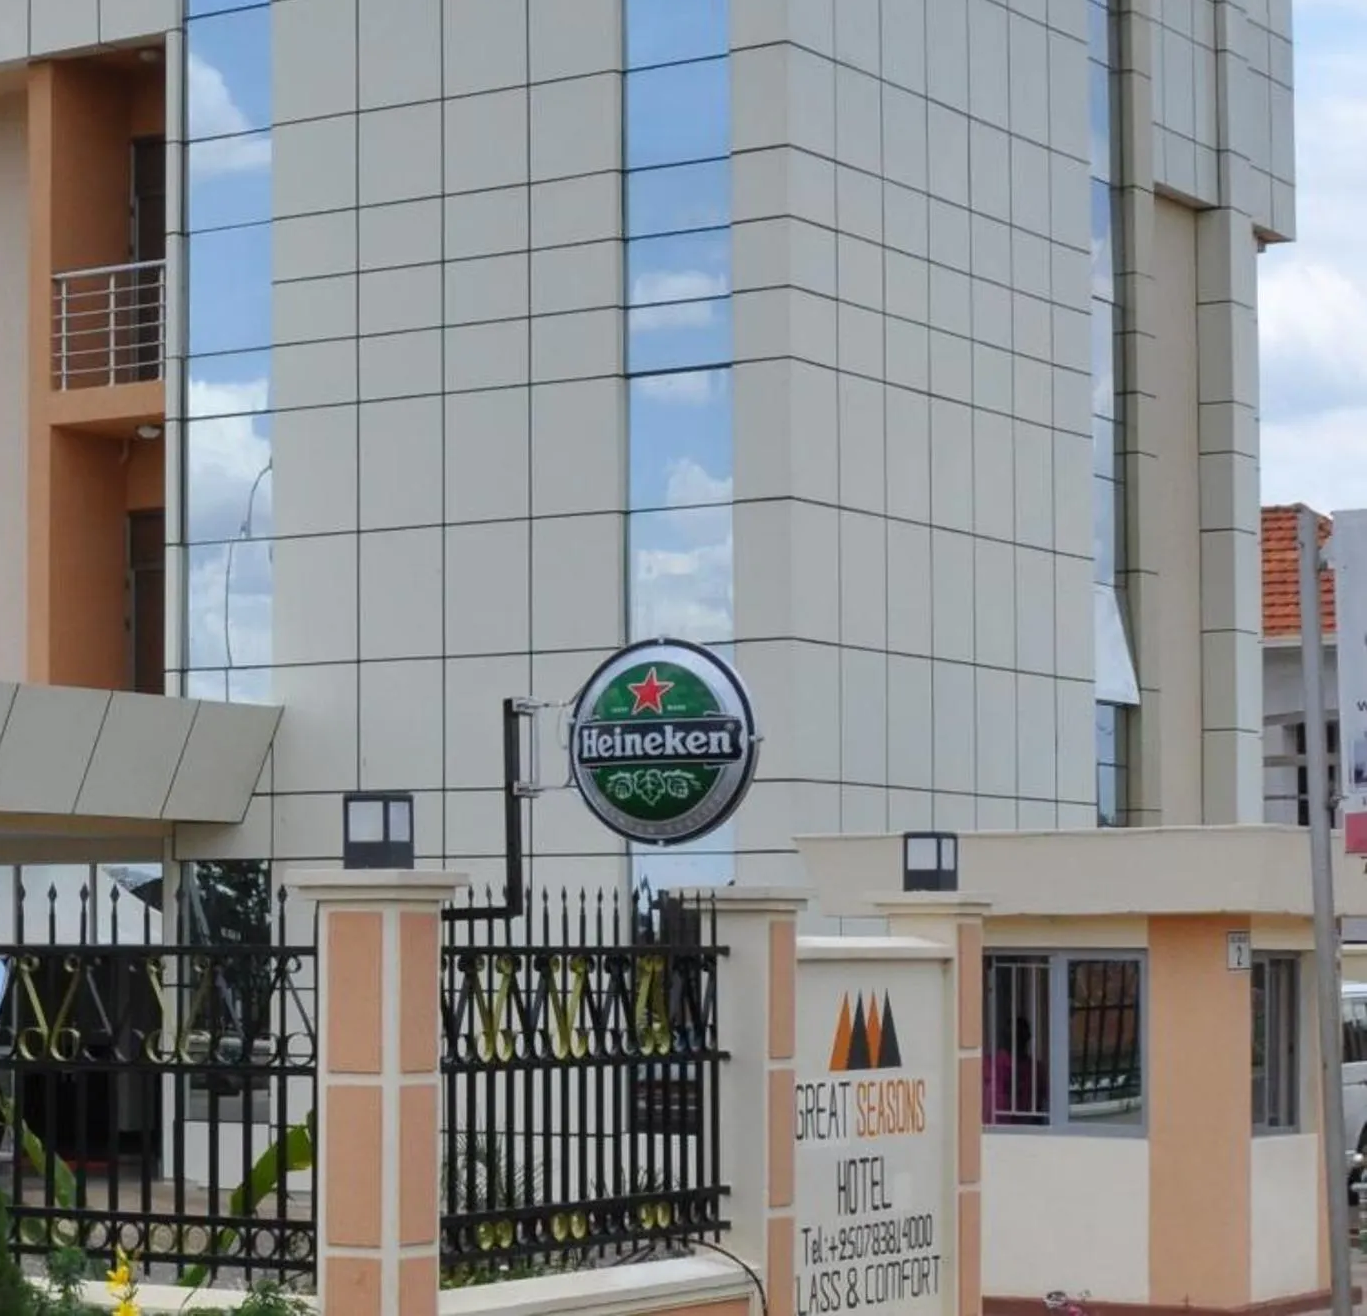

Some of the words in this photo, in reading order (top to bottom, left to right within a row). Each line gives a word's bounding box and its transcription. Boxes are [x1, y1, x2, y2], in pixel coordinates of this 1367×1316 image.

[583, 725, 732, 758] Heineken
[795, 1082, 851, 1141] GREAT
[856, 1078, 926, 1138] SEASONS
[837, 1156, 892, 1215] HOTEL
[795, 1269, 841, 1316] LASS
[846, 1267, 860, 1309] &
[865, 1255, 940, 1304] COMFORT
